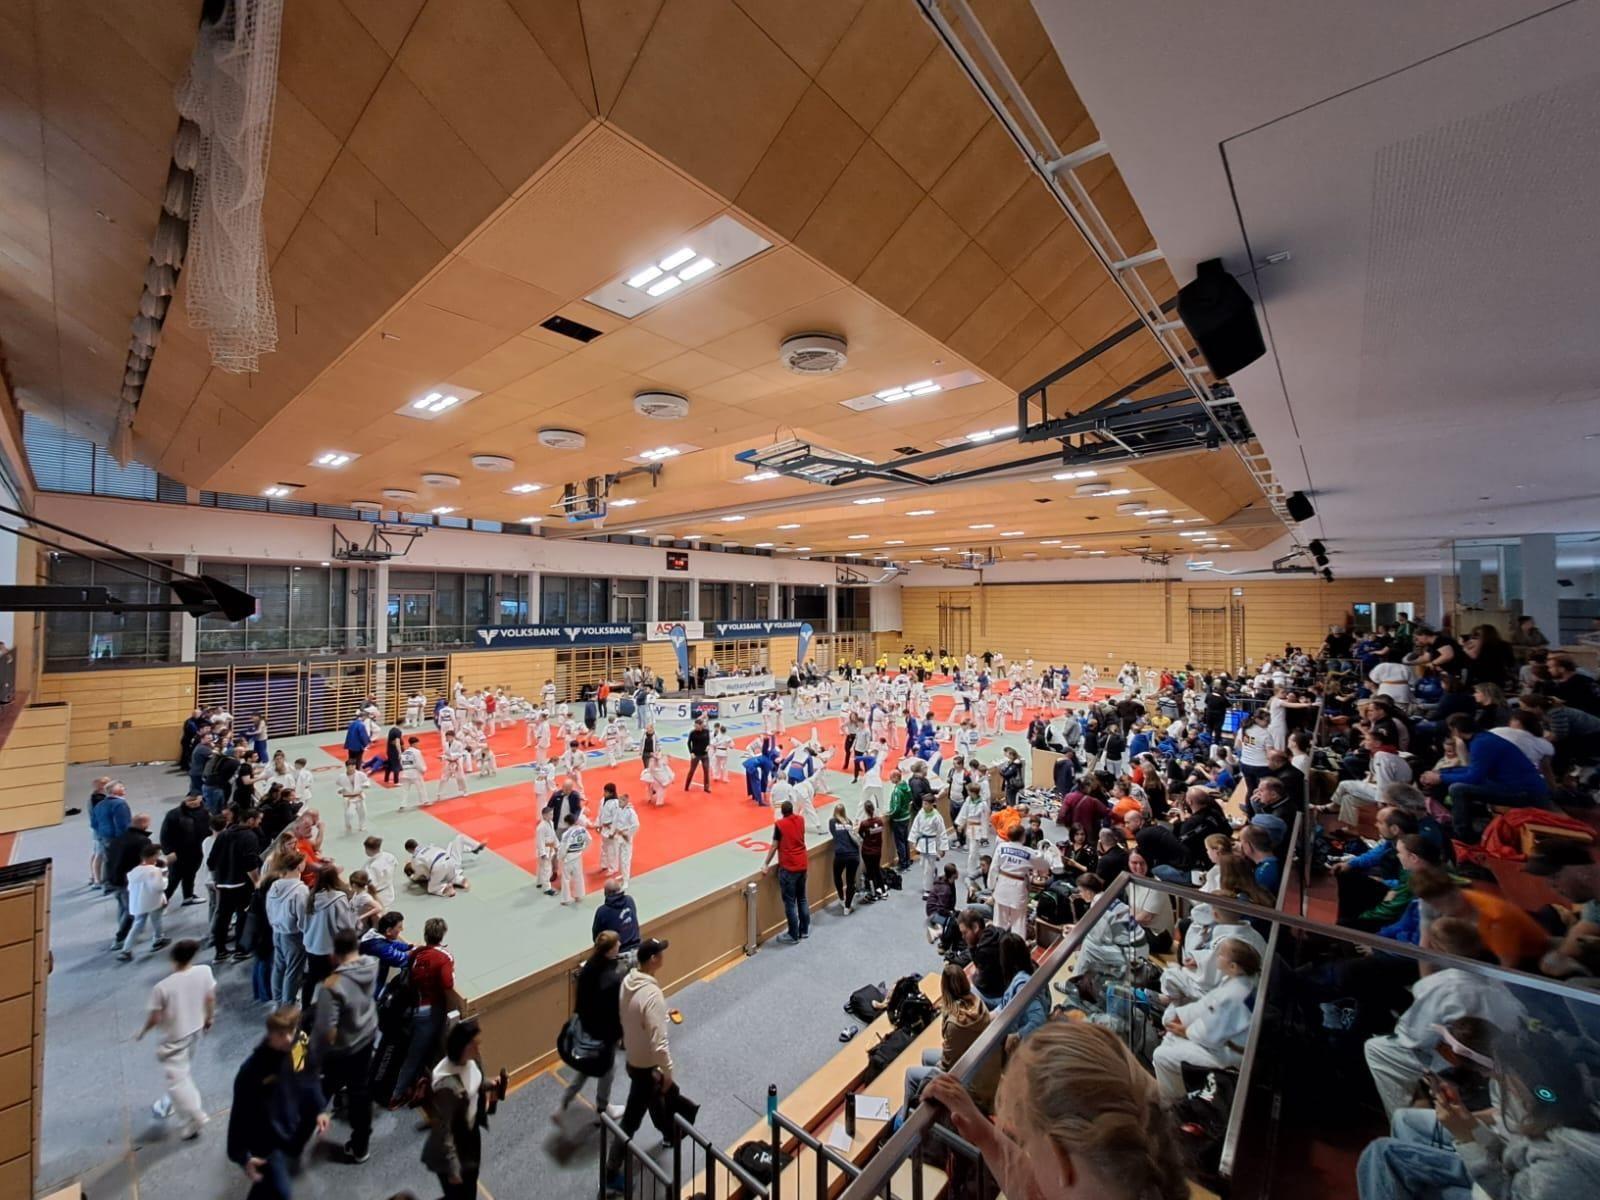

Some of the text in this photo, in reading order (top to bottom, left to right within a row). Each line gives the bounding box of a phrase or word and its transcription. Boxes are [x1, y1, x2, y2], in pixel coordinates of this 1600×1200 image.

[728, 622, 761, 630] VOLKSBANK
[501, 627, 631, 637] VOLKSBANK VOLKSBANK
[678, 704, 687, 717] 5
[748, 699, 755, 711] 4
